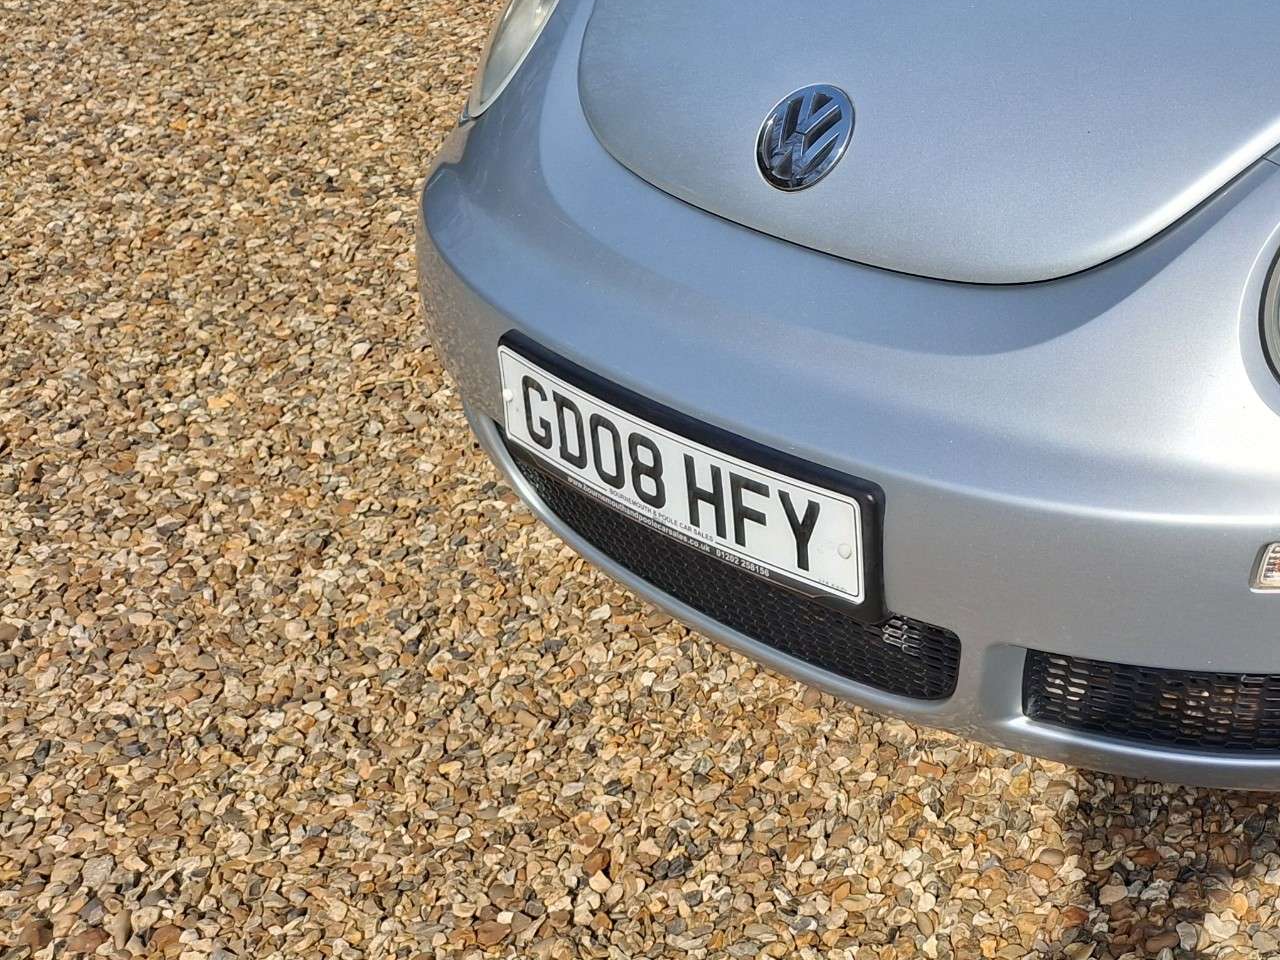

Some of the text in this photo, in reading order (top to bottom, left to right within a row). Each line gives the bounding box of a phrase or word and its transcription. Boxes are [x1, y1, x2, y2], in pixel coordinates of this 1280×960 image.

[521, 375, 821, 572] GD08 HFY
[658, 513, 679, 527] POOLE
[679, 522, 693, 532] CAR
[693, 526, 714, 542] SALES
